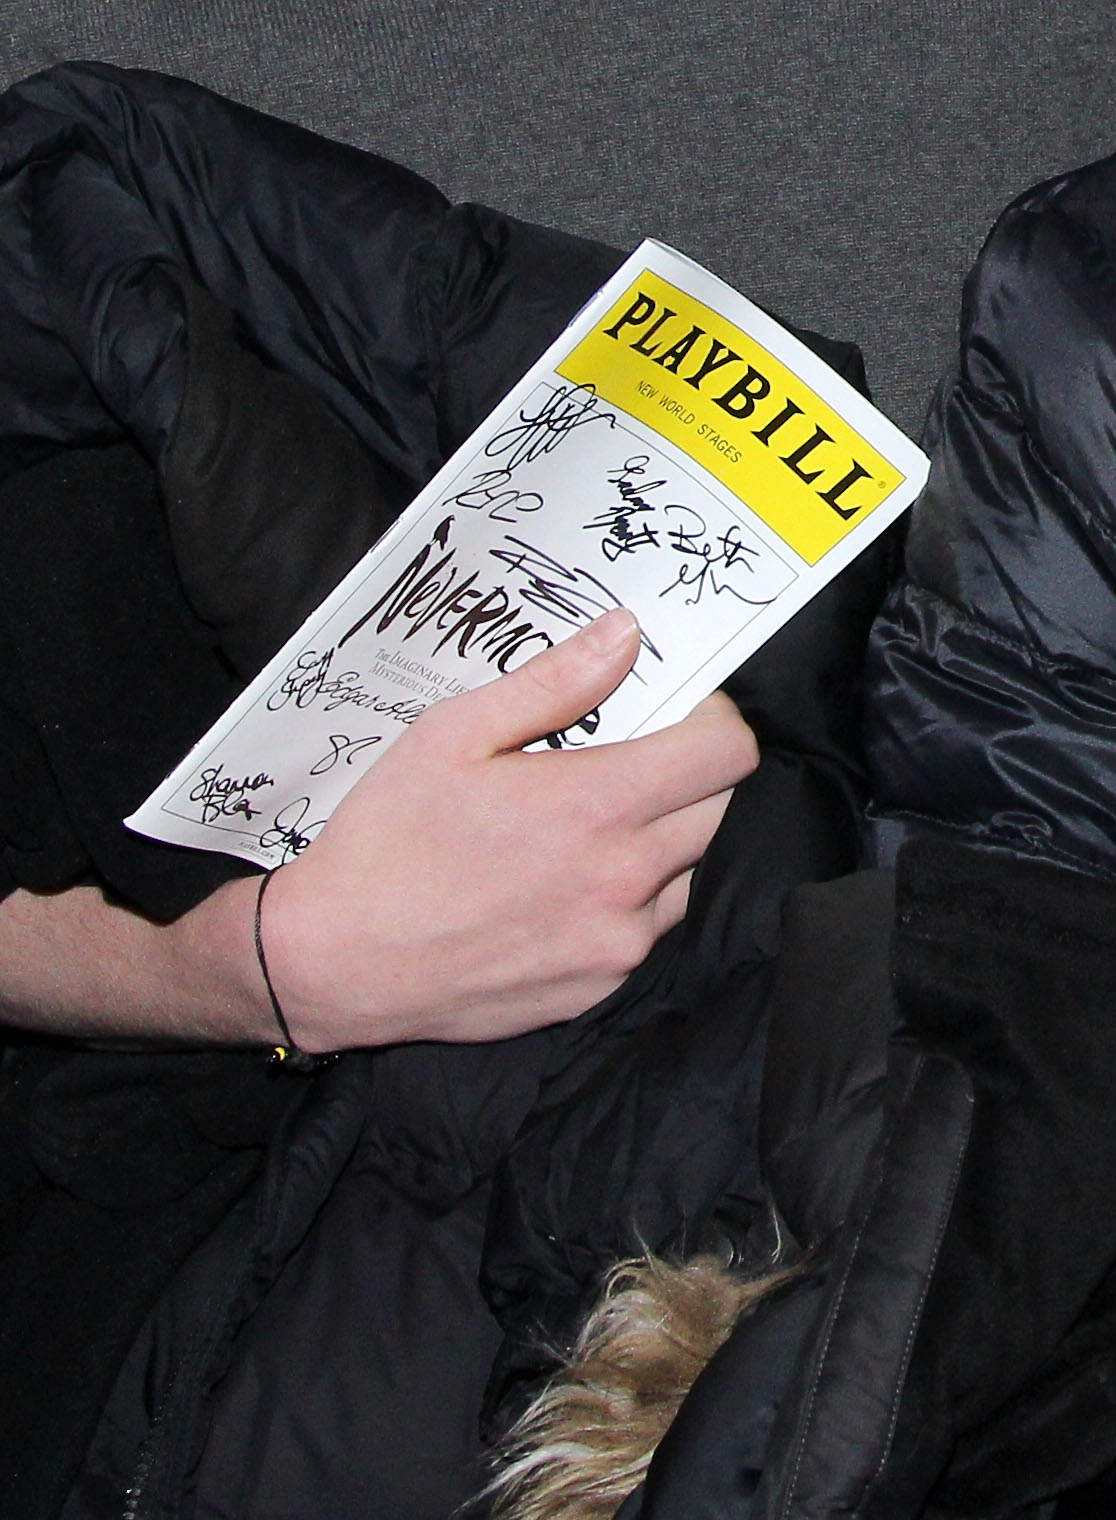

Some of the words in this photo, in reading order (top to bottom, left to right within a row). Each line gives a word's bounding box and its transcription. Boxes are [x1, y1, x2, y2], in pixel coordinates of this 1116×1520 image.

[603, 291, 874, 521] PLAYBILL
[635, 380, 658, 400] NEW
[658, 394, 695, 425] WORLD
[696, 423, 743, 464] STAGES
[368, 661, 425, 694] MYSTERIOUS
[388, 650, 448, 687] IMAGINARY
[317, 671, 376, 711] Edgar
